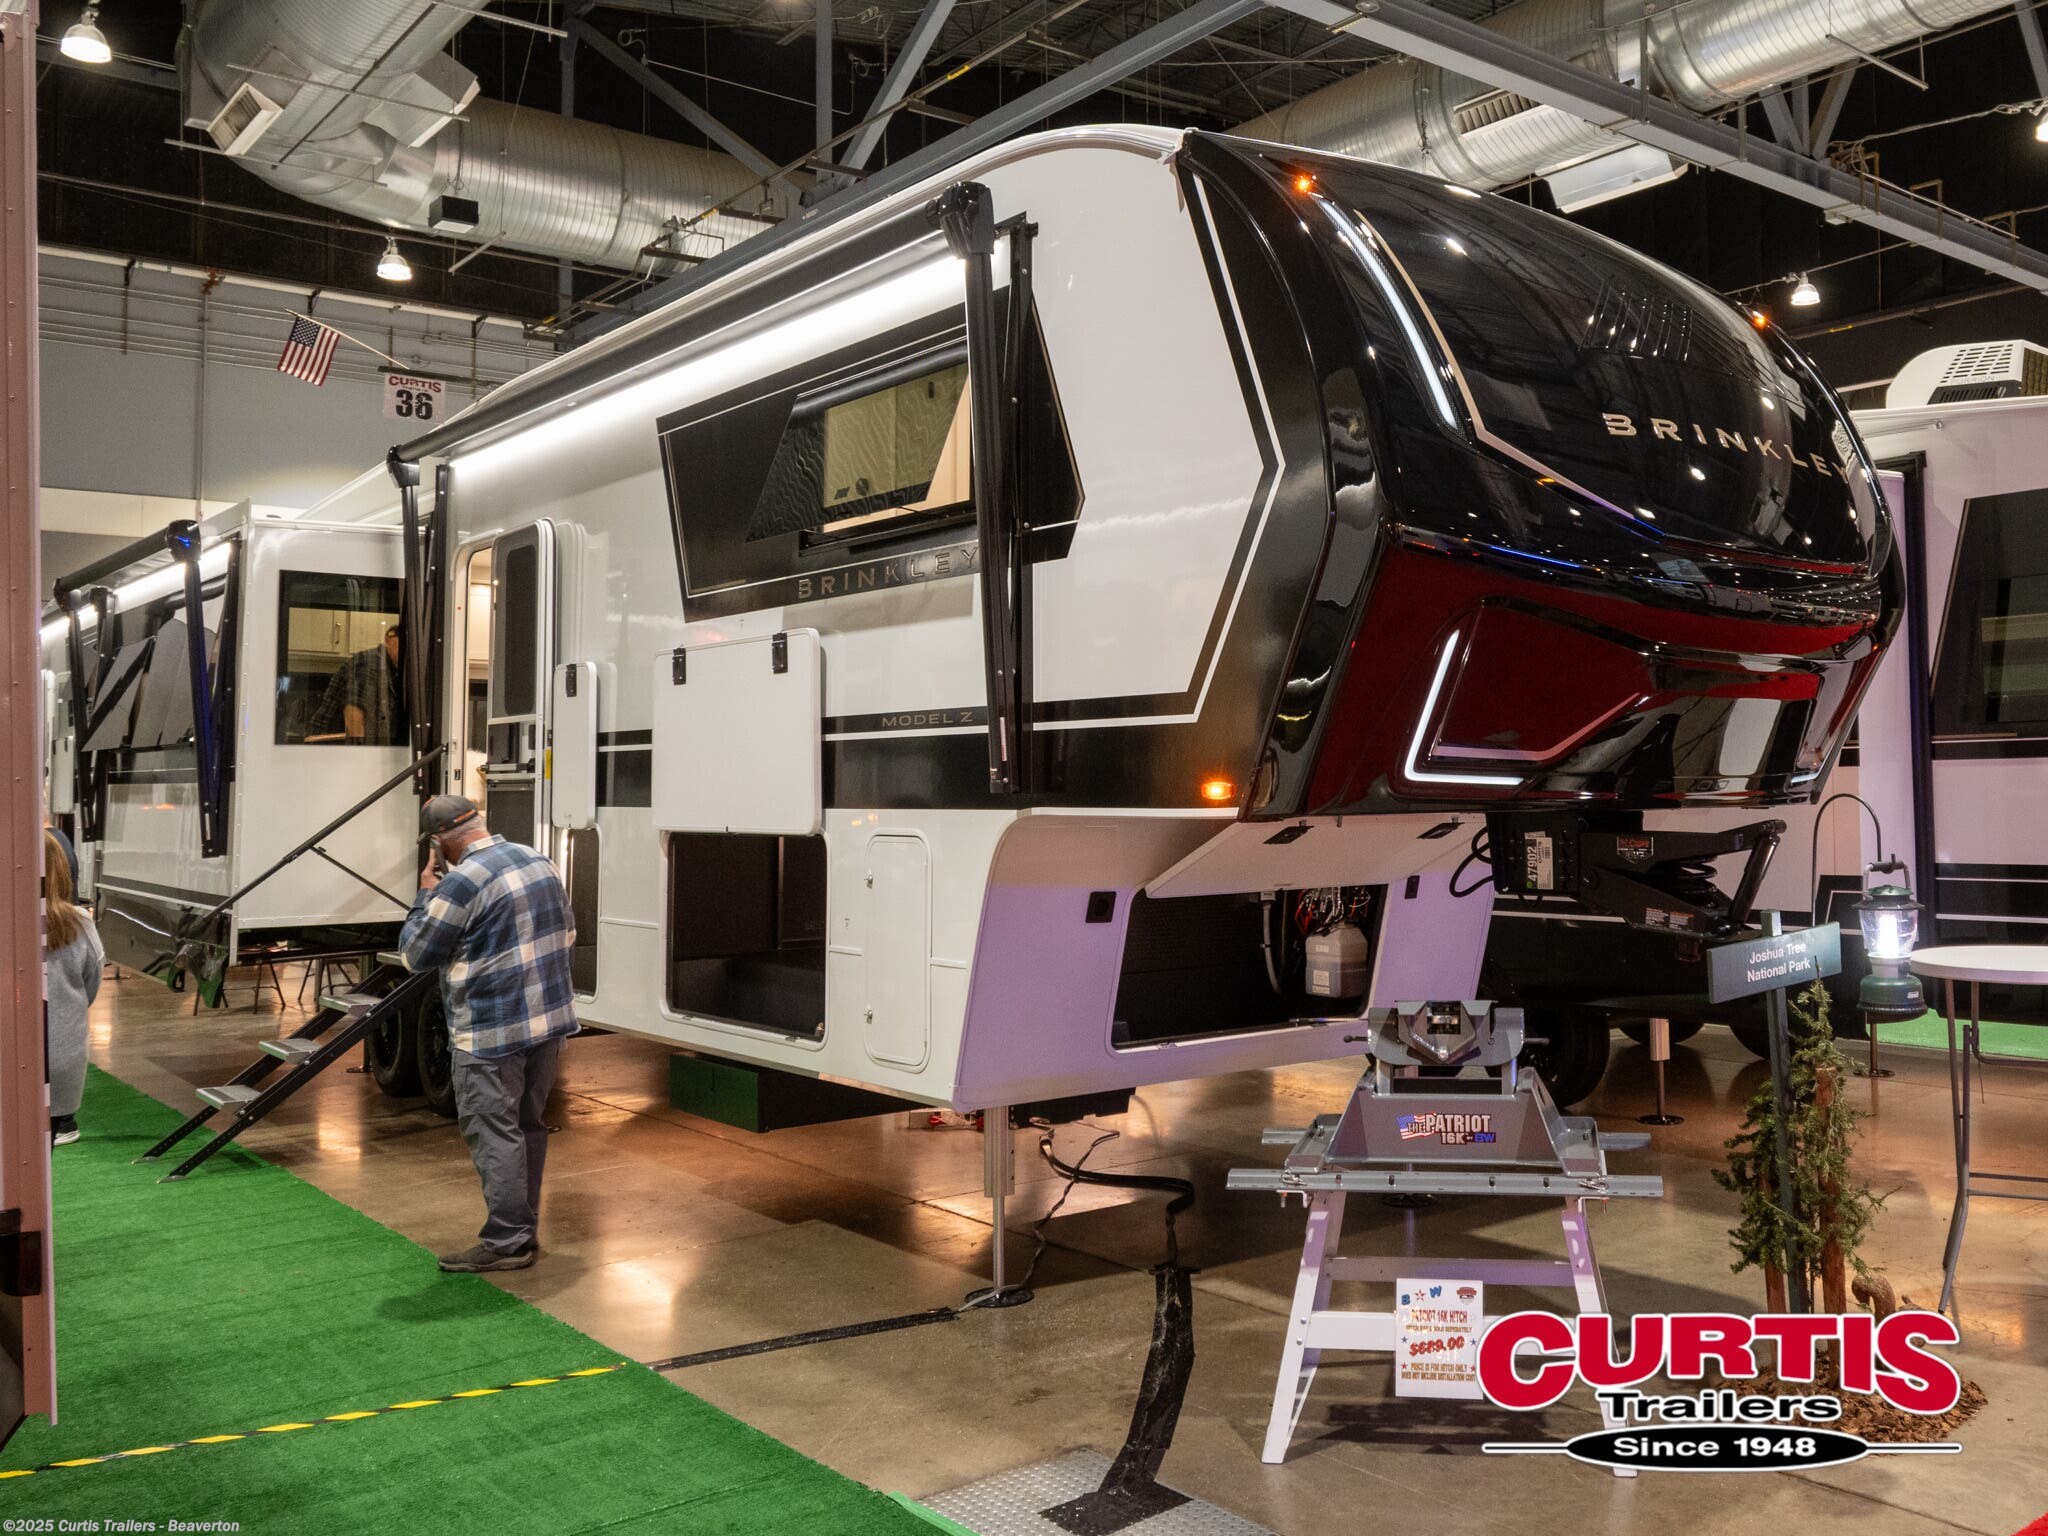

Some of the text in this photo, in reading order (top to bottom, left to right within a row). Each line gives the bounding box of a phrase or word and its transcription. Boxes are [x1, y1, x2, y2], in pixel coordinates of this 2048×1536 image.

[389, 376, 441, 393] CURTIS
[396, 389, 432, 420] 36
[1602, 413, 1849, 484] BRINKLEY
[798, 546, 977, 598] BRINKLEY
[882, 711, 974, 727] MODEL Z
[1527, 846, 1538, 882] 47902
[1749, 942, 1807, 965] Joshua Tree
[1747, 957, 1811, 982] National Park
[1408, 1114, 1491, 1133] THE PATRIOT
[1441, 1133, 1465, 1144] 16K
[1449, 1310, 1468, 1324] HITCH
